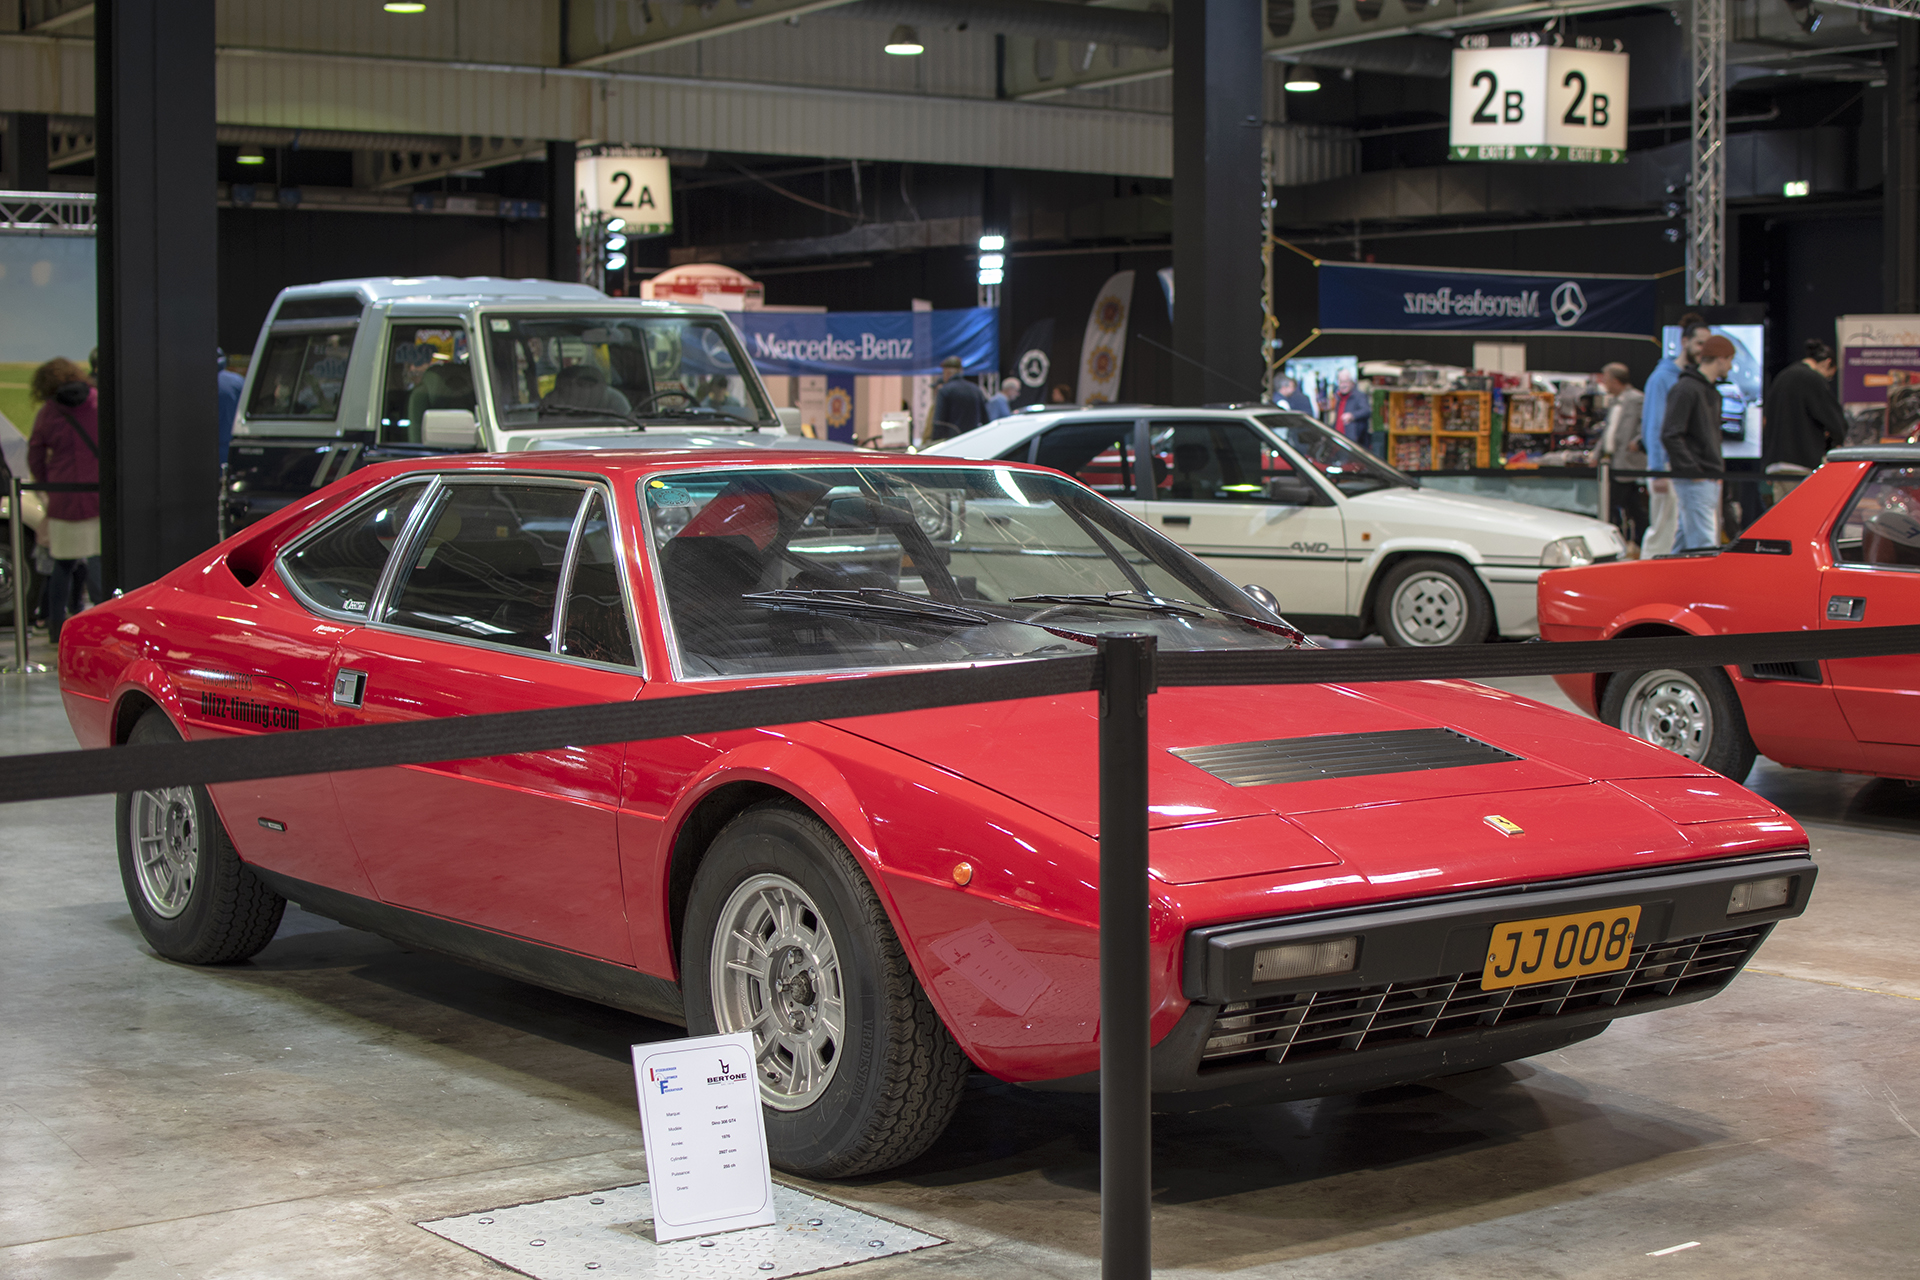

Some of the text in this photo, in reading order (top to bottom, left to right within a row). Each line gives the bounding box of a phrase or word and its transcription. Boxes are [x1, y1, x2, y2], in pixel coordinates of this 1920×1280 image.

[1471, 69, 1524, 124] 2B
[1563, 69, 1609, 127] 2B
[612, 170, 655, 208] 2A
[754, 332, 913, 361] Mercedes-Benz
[201, 690, 299, 730] blizz-timing.com
[707, 1072, 747, 1083] BERTONE
[852, 1018, 874, 1100] VREDESTEIN
